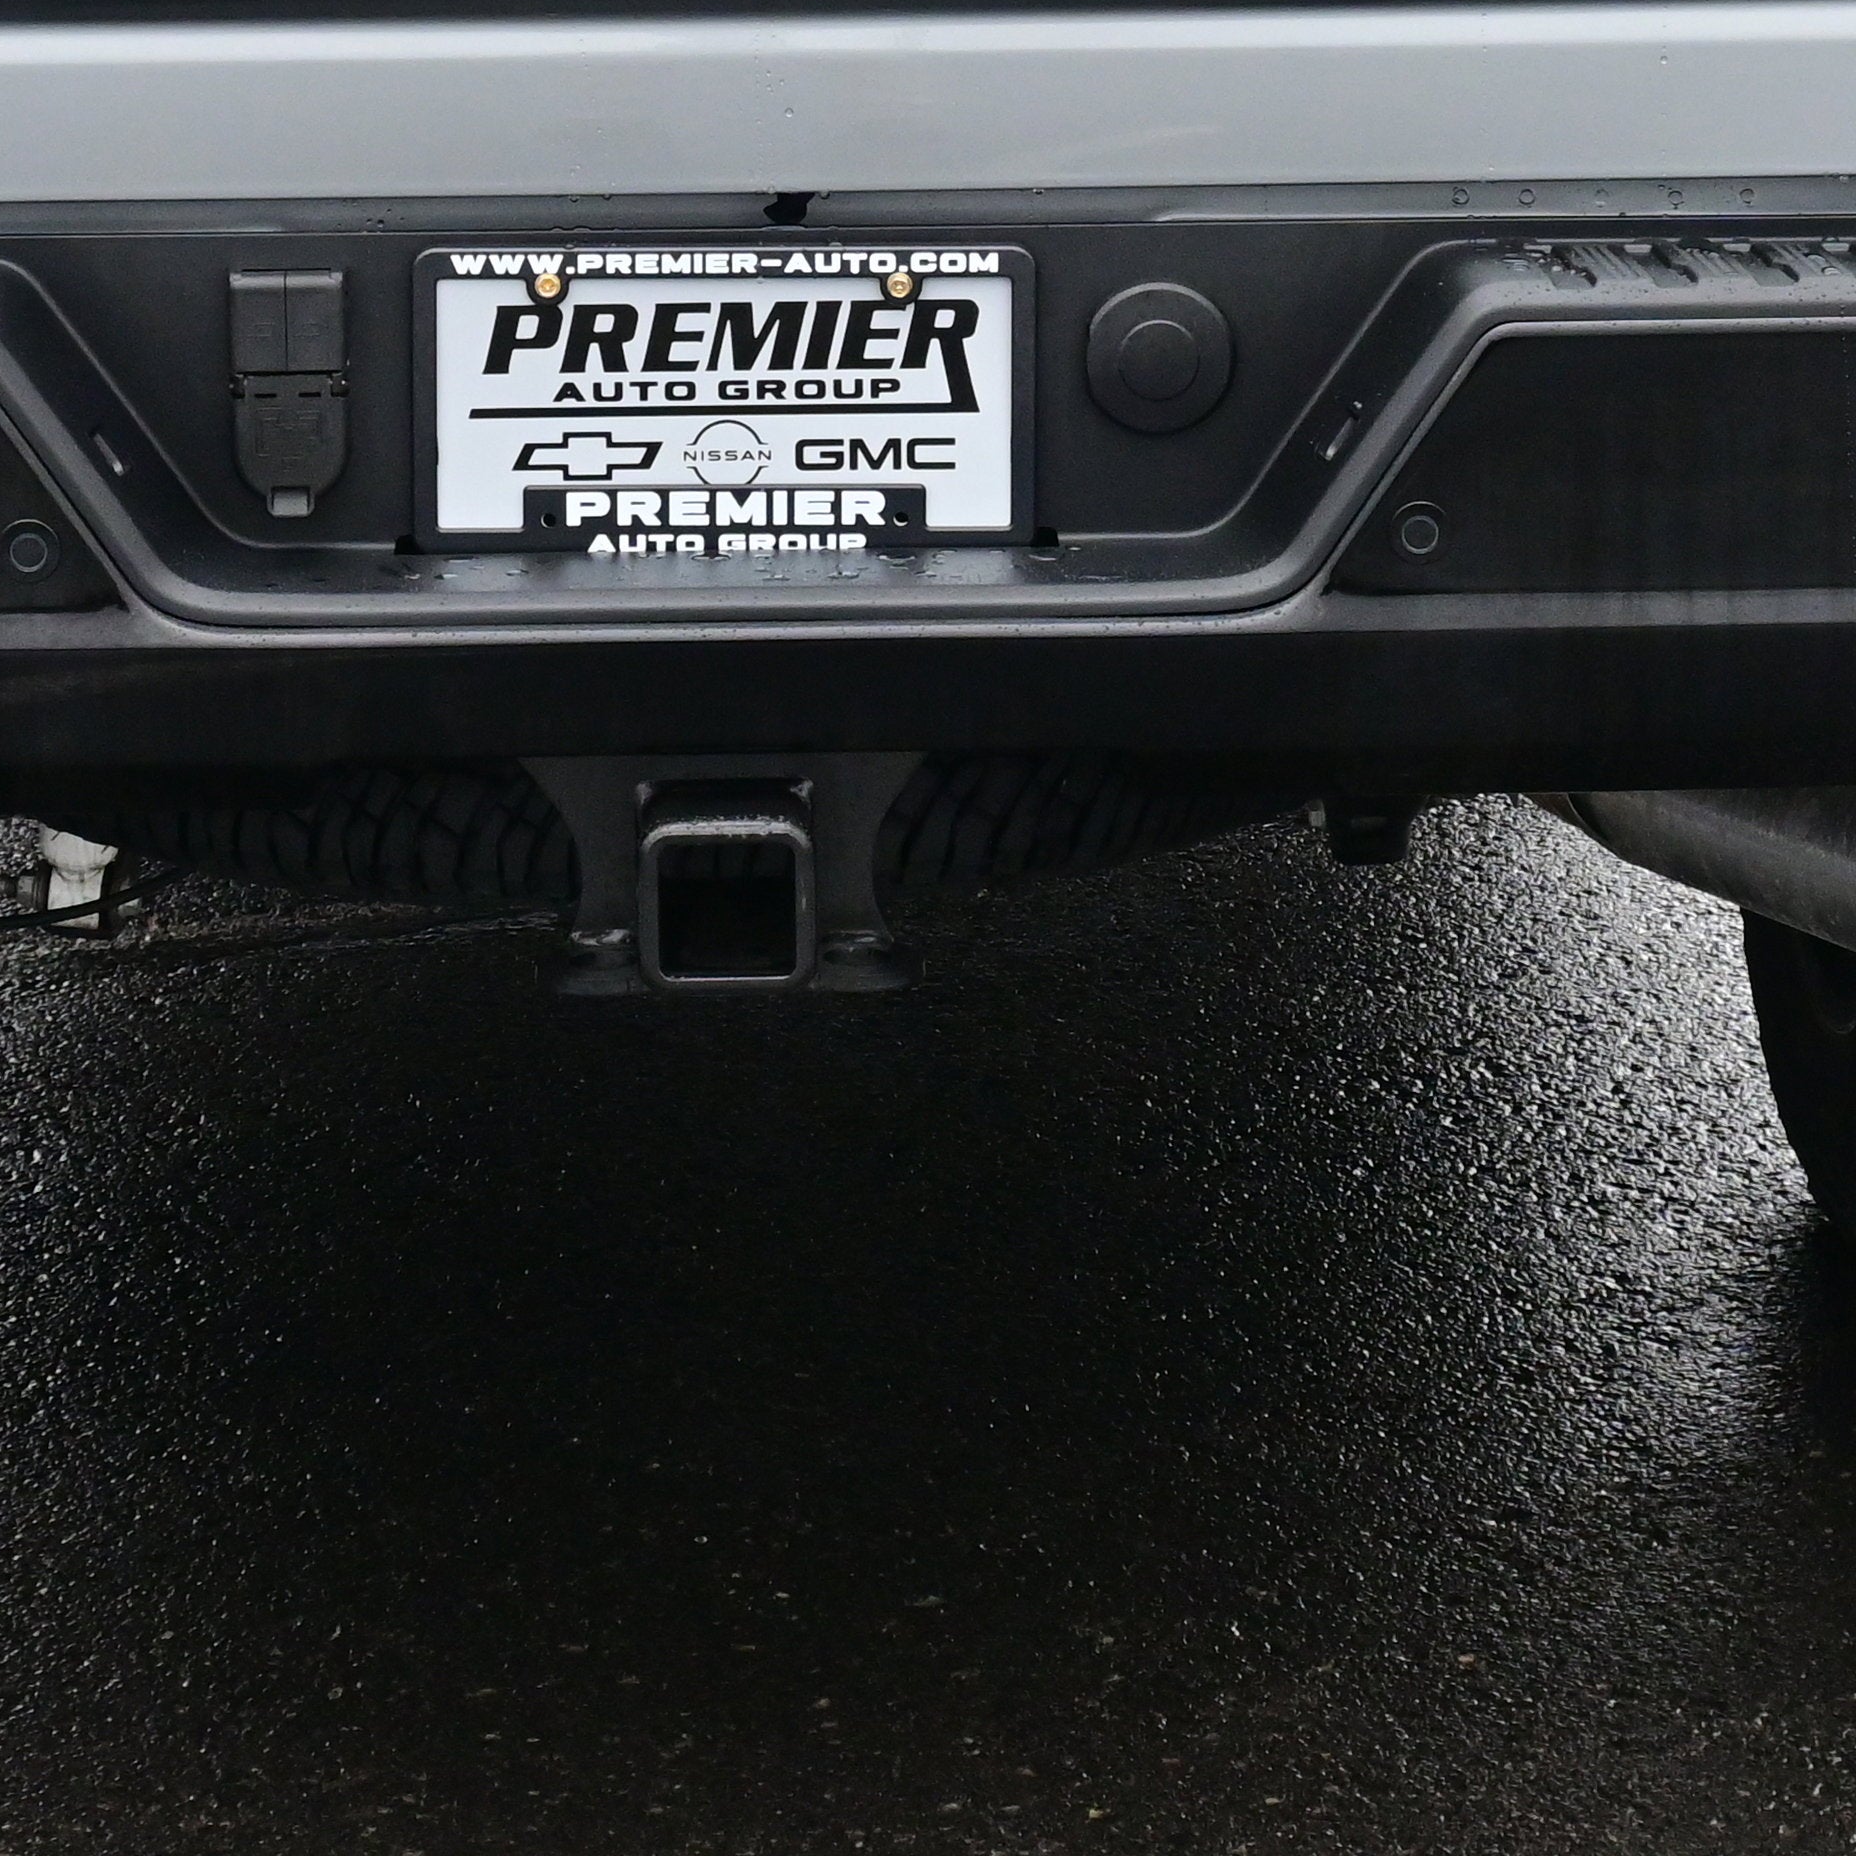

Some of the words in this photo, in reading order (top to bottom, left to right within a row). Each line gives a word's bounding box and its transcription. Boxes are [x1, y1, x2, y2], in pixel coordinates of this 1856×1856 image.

[449, 252, 1000, 275] WWW.PREMIER-AUTO.COM
[482, 298, 980, 379] PREMIER
[552, 380, 697, 402] AUTO
[717, 378, 902, 401] GROUP
[682, 449, 773, 463] NISSAN
[795, 437, 957, 471] GMC
[565, 490, 887, 527] PREMIER
[587, 533, 706, 553] AUTO
[717, 533, 868, 552] GROUP
